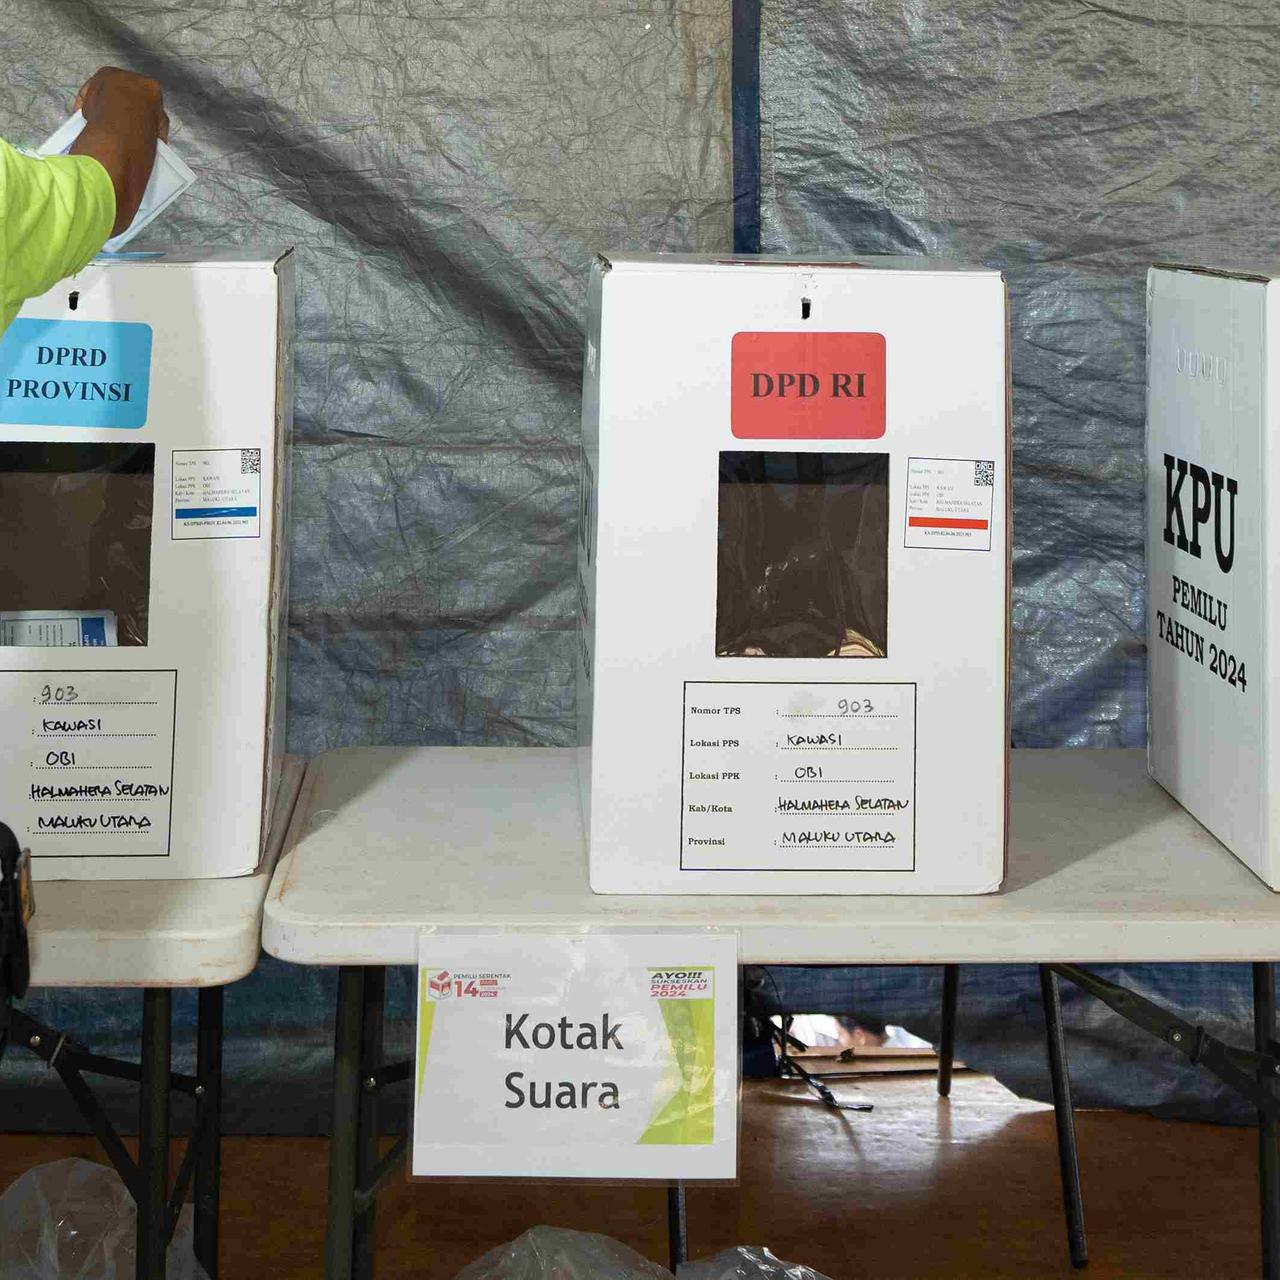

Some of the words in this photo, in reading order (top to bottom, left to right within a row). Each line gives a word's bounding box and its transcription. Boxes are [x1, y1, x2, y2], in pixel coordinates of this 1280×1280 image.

[36, 345, 107, 367] DPRD
[7, 378, 133, 403] PROVINSI
[750, 373, 821, 398] DPD
[831, 373, 867, 398] RI
[1164, 453, 1238, 573] KPU
[1172, 575, 1228, 631] PEMILU
[1157, 610, 1204, 665] TAHUN
[1209, 643, 1247, 693] 2024
[41, 685, 79, 703] 903
[691, 706, 720, 715] Nomor
[723, 706, 741, 715] TPS
[838, 699, 874, 715] 903
[43, 719, 101, 732] KAWASI
[690, 739, 720, 747] Lokasi
[722, 739, 739, 747] PPS
[787, 733, 842, 746] KAWASI
[46, 752, 75, 766] OBI
[689, 772, 719, 780] Lokasi
[722, 772, 740, 780] PPK
[794, 766, 822, 779] OBI
[114, 780, 169, 796] SELATAN
[689, 804, 733, 813] Kab/Kota
[778, 797, 850, 811] HALMAHERA
[855, 795, 909, 810] SELATAN
[38, 816, 97, 829] MALUKU
[100, 814, 151, 828] UTARA
[688, 837, 725, 846] Provinsi
[782, 831, 840, 844] MALUKU
[845, 831, 896, 843] UTARA
[455, 980, 479, 997] 14
[504, 1013, 624, 1050] Kotak
[505, 1072, 620, 1109] Suara
